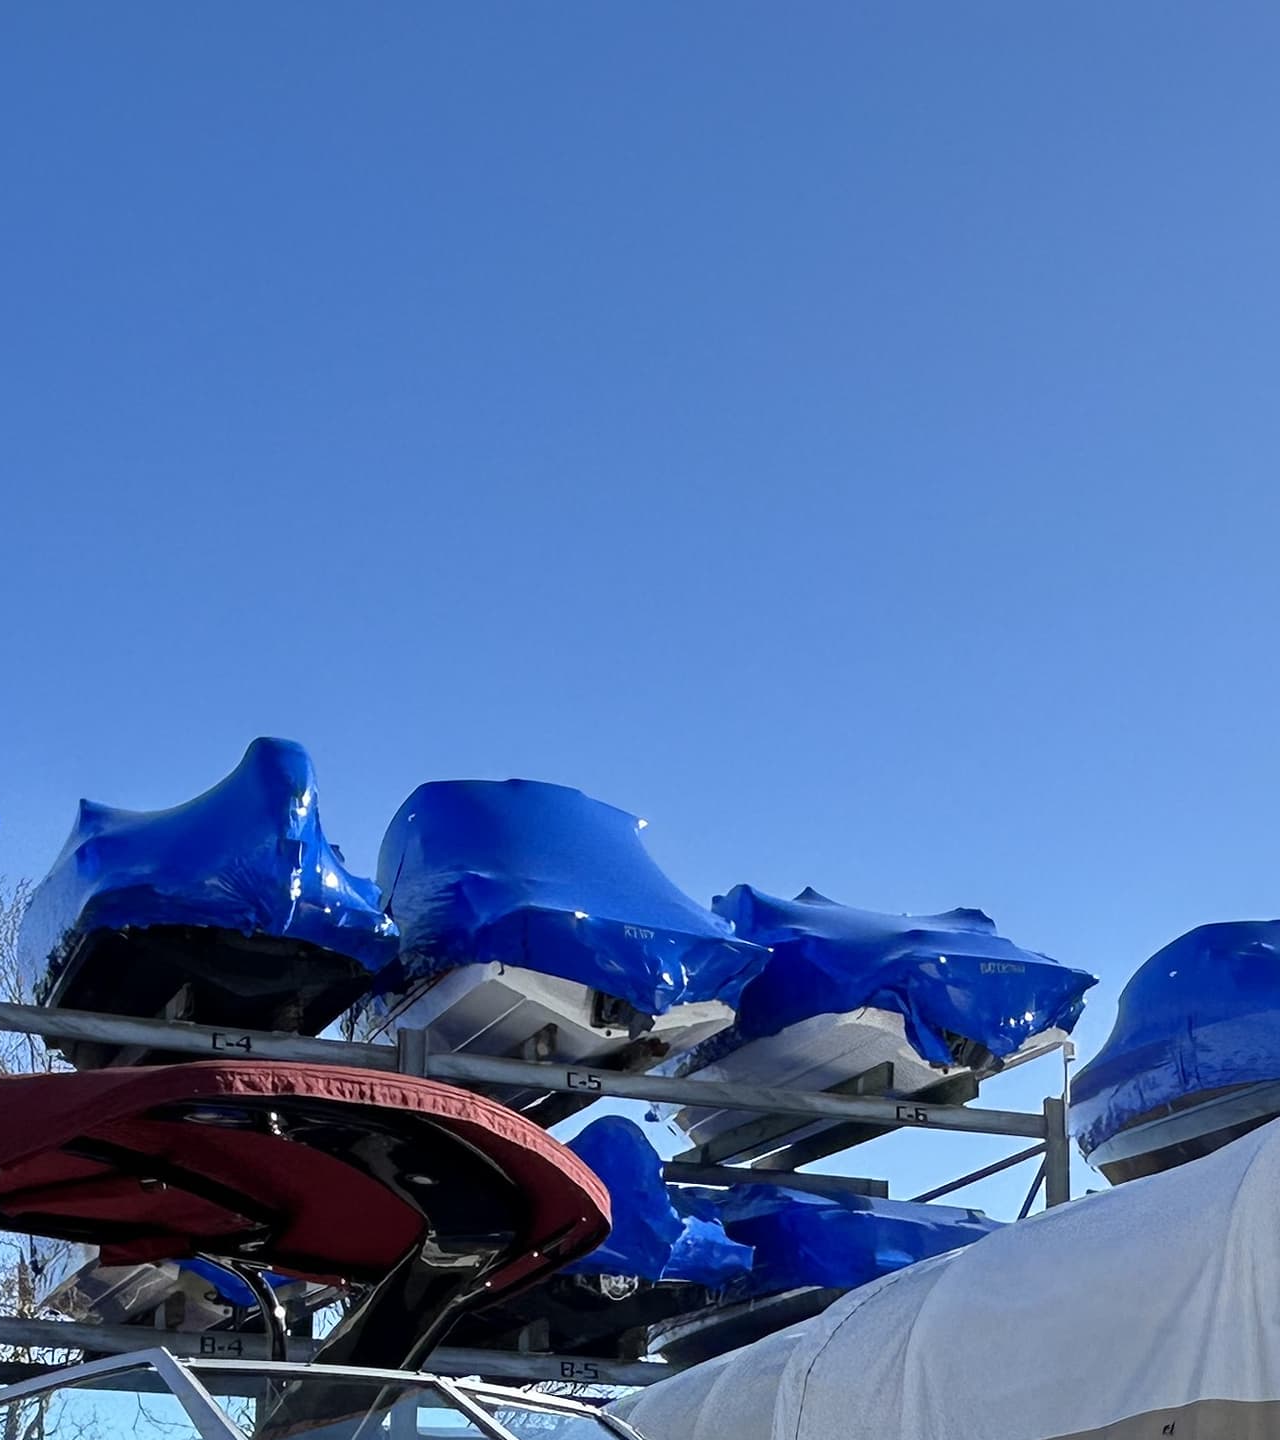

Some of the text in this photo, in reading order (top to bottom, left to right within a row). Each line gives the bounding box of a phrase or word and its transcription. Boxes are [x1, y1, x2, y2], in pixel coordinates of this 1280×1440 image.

[211, 1032, 252, 1054] C-4
[566, 1071, 602, 1092] C-5
[895, 1105, 928, 1124] C-6
[199, 1335, 244, 1357] B-4
